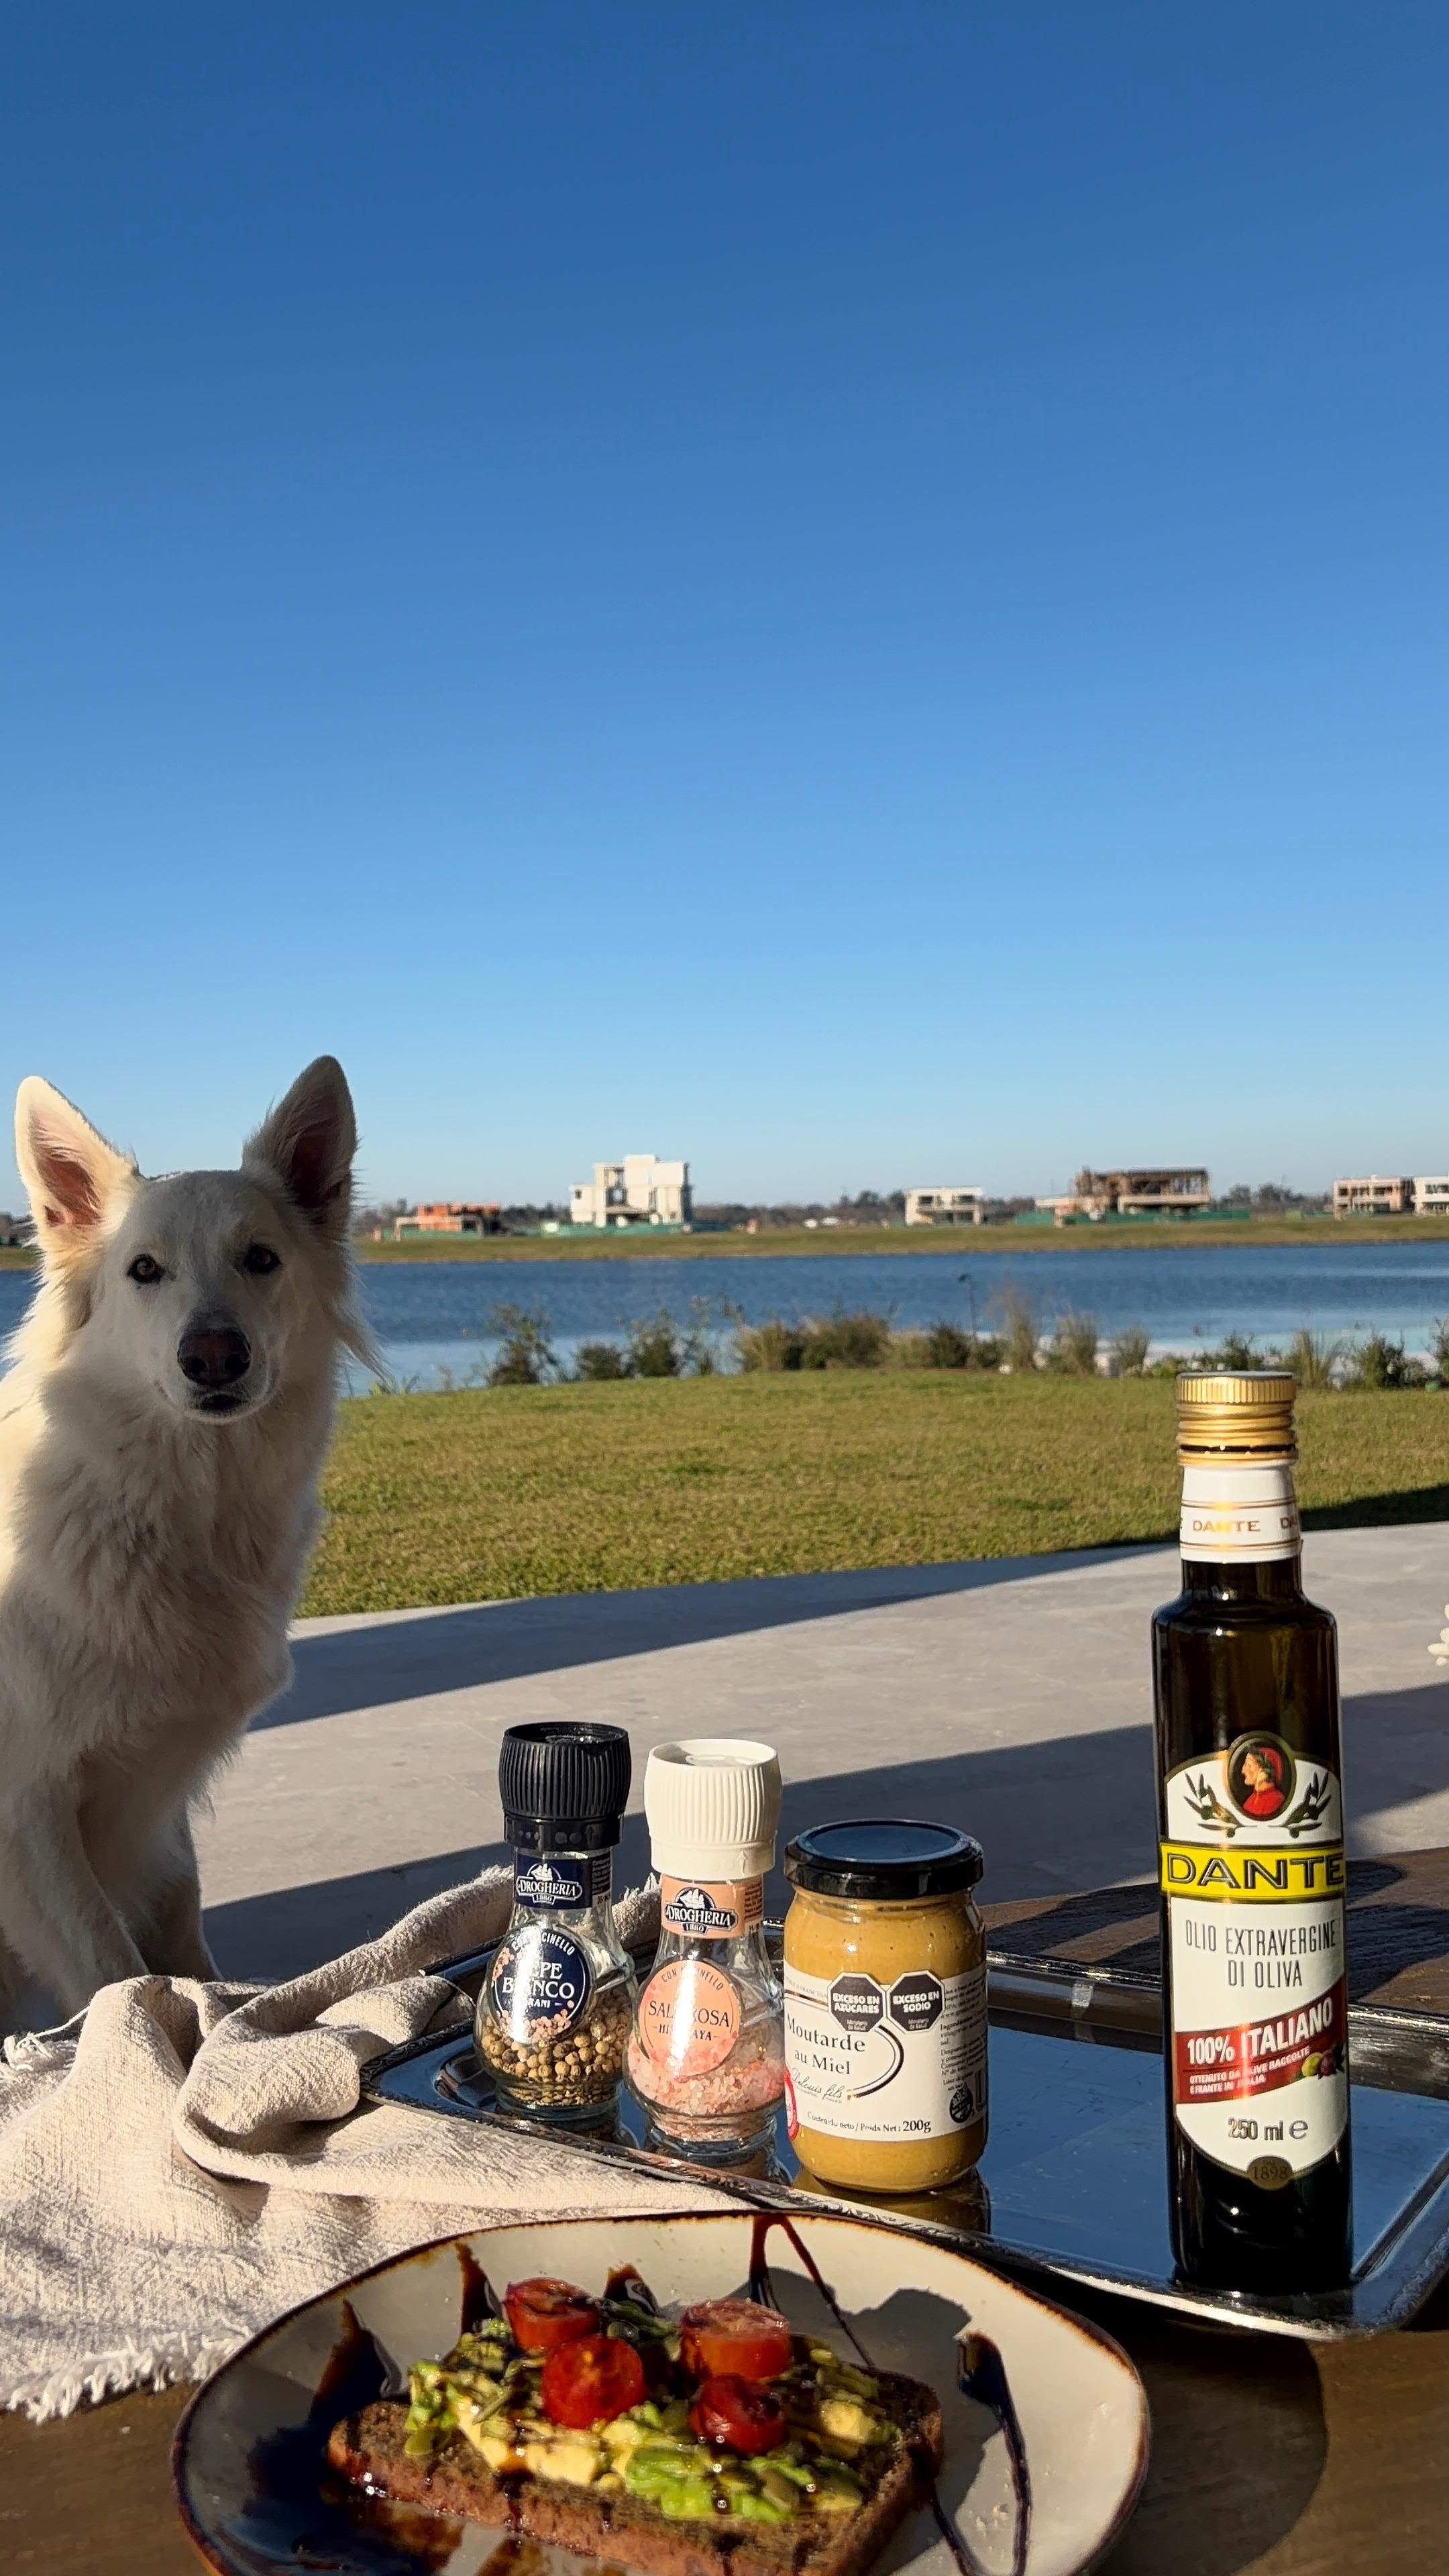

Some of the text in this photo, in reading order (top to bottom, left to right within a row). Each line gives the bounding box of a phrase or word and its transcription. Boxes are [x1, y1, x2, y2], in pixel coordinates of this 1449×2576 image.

[1167, 1852, 1344, 1890] DANTE
[520, 1879, 576, 1896] DROGHERIA
[667, 1906, 731, 1927] DROGHERIA
[686, 1923, 704, 1932] 1880
[1185, 1919, 1336, 1956] OLIO EXTRAVERGINE
[536, 1931, 576, 1955] CINELLO
[661, 1968, 677, 1982] CON
[1228, 1960, 1303, 1988] DI OLIVA
[502, 1977, 575, 1999] BNCO
[893, 1990, 939, 2004] EXCESO EN
[525, 1997, 551, 2008] RANI
[833, 1992, 879, 2005] EXCESO EN
[903, 2002, 931, 2013] SODIO
[648, 2000, 673, 2019] SAL
[659, 2023, 712, 2041] HIAYA
[787, 2012, 865, 2052] Moutarde
[1187, 1997, 1334, 2065] 100% ITALIANO
[794, 2050, 850, 2074] au Miel
[1190, 2072, 1227, 2084] OTTENUTO
[1244, 2061, 1268, 2078] LIVE
[1269, 2046, 1311, 2070] RACCOLTE
[902, 2118, 931, 2133] 200g
[1228, 2116, 1258, 2140] 250
[1264, 2119, 1284, 2141] ml
[1253, 2165, 1289, 2180] 1898
